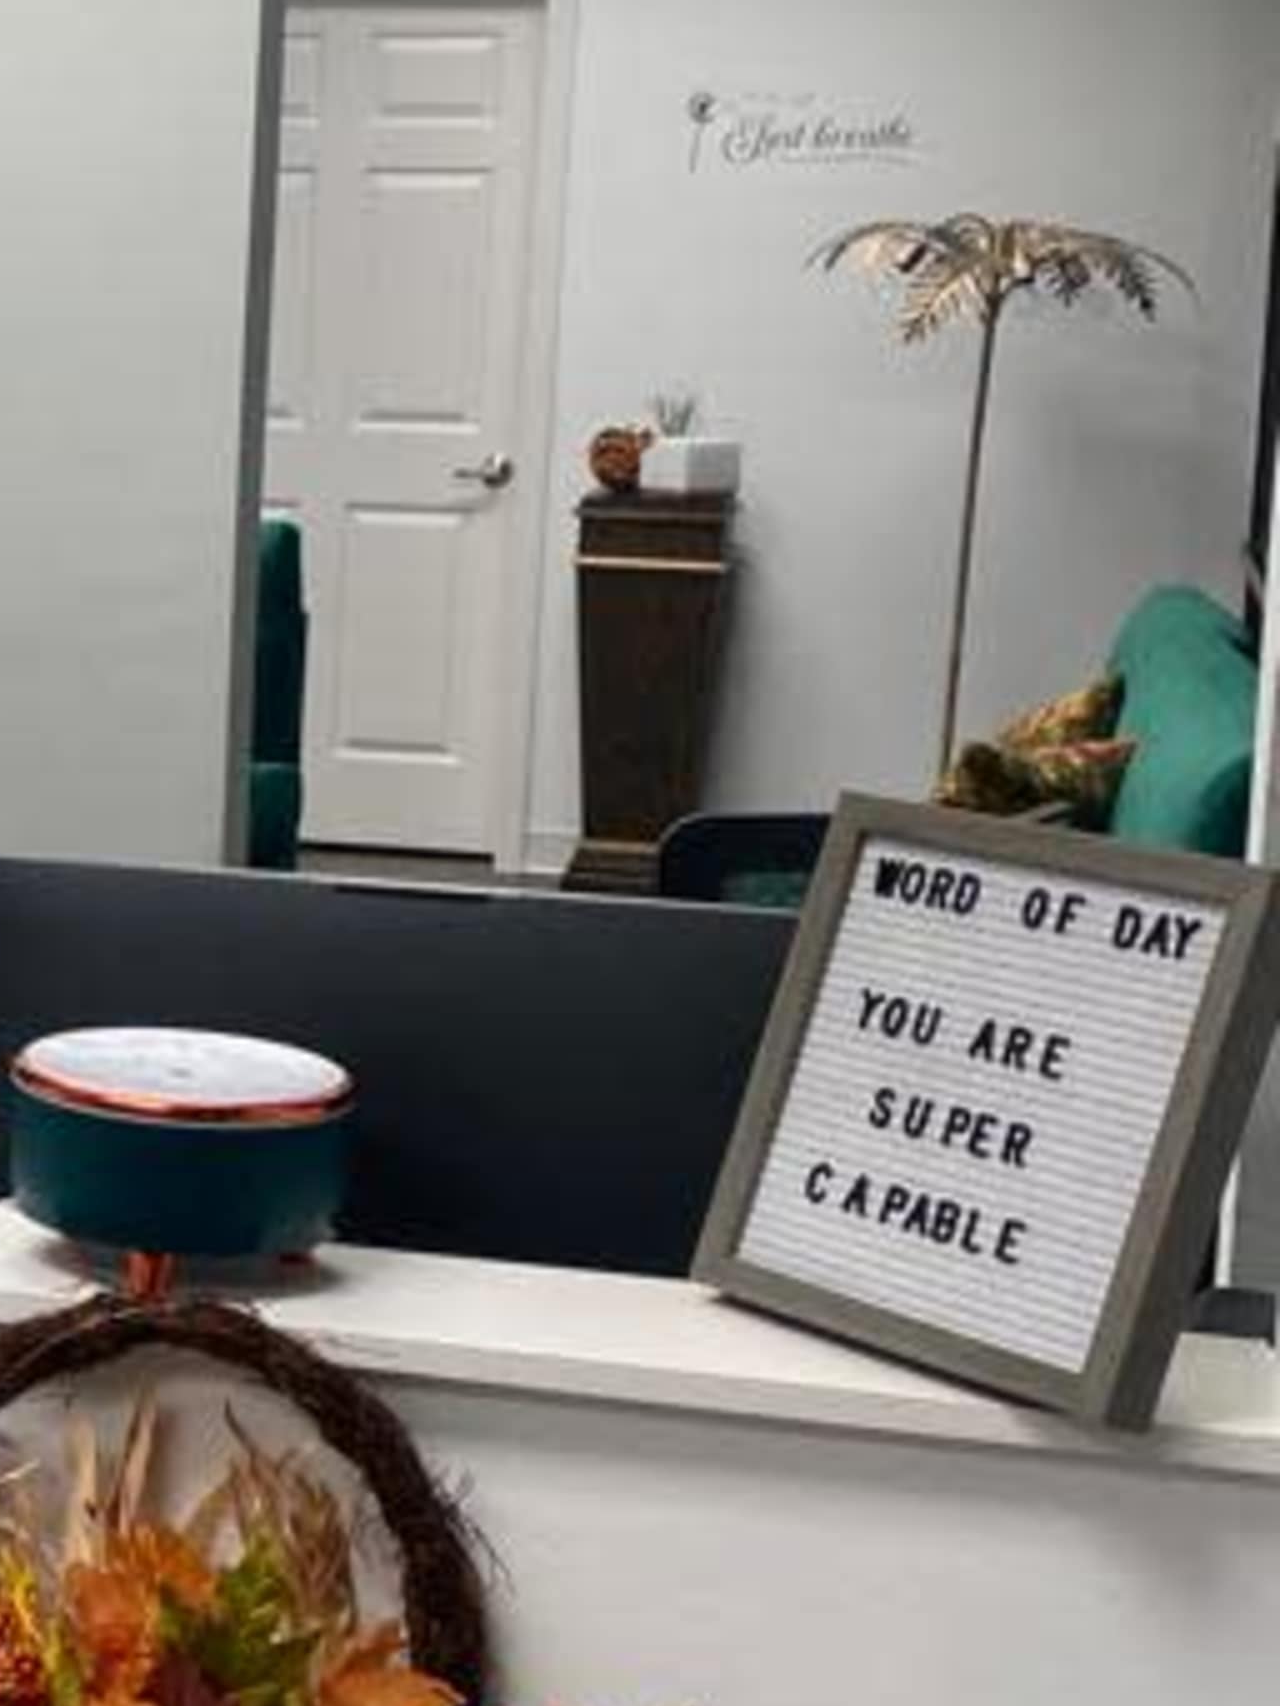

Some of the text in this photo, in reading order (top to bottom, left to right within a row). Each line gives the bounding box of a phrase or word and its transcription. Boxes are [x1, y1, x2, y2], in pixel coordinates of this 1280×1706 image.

[874, 857, 1204, 961] WORD OF DAY
[858, 988, 1073, 1081] YOU ARE
[867, 1087, 1035, 1169] SUPER
[804, 1162, 1028, 1266] CAPABLE
